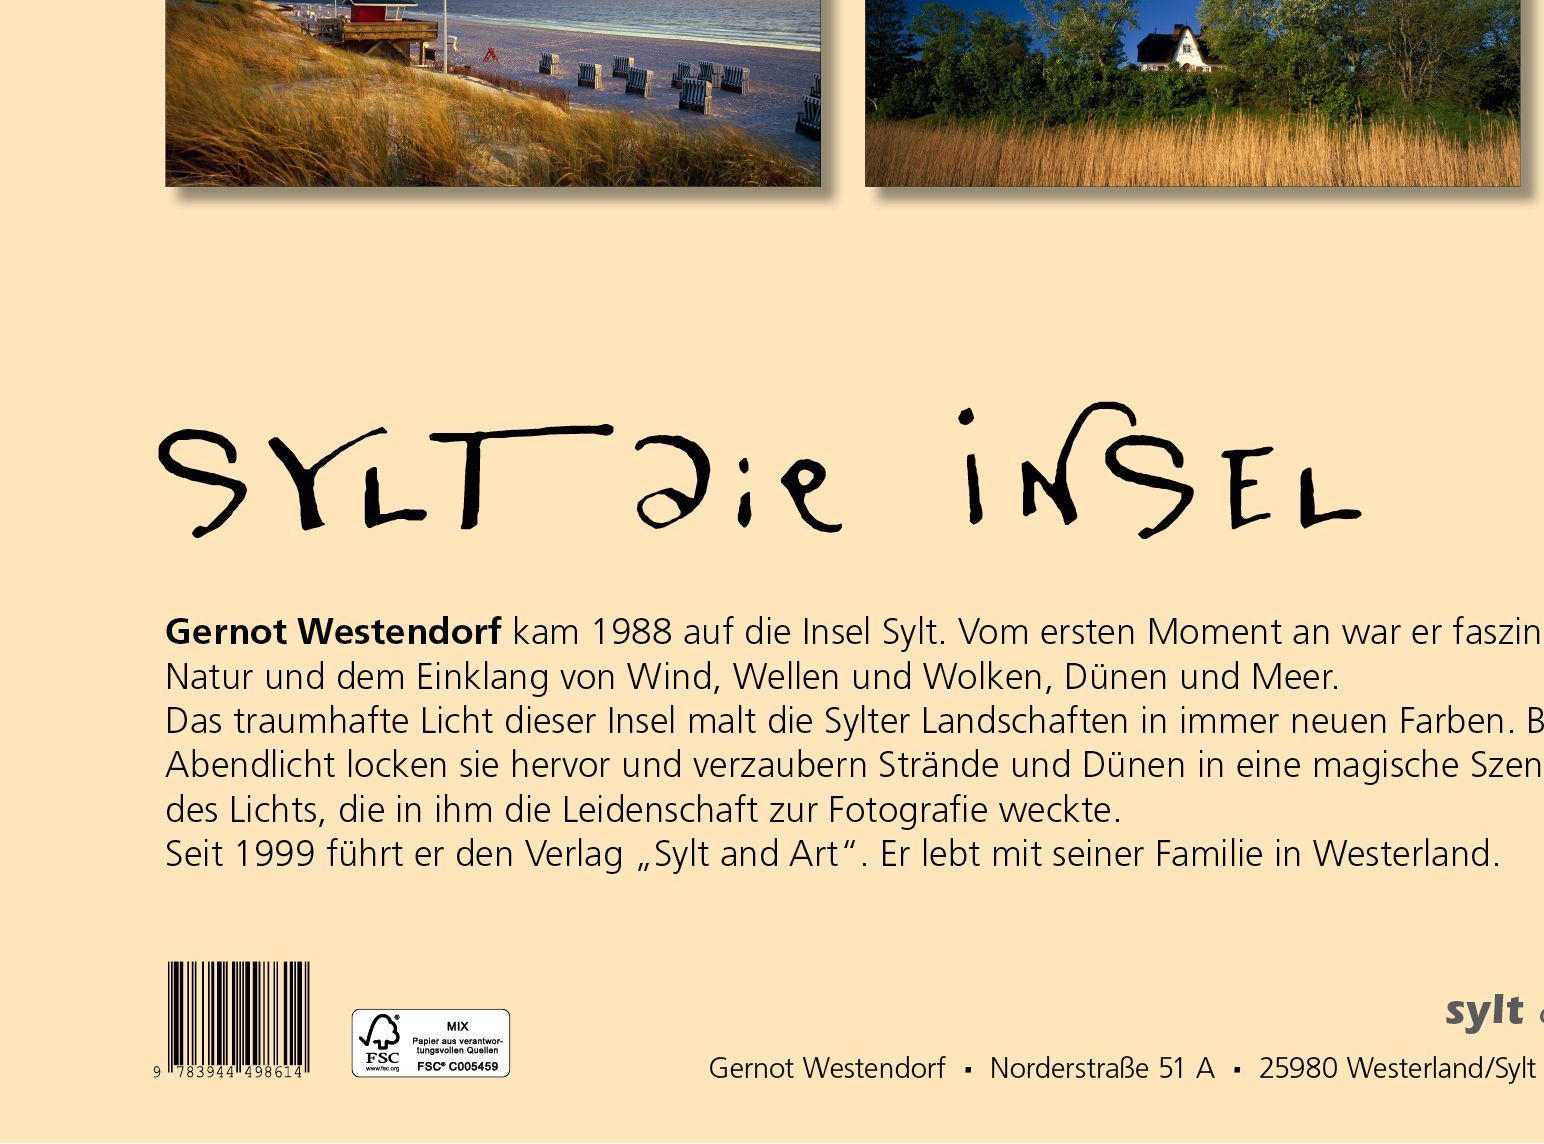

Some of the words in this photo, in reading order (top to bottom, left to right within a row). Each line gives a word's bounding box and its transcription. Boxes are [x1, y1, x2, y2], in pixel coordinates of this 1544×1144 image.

[157, 423, 615, 539] SYLT
[634, 434, 843, 534] die
[165, 617, 288, 646] Gernot
[296, 615, 503, 646] Westendorf
[514, 615, 578, 645] kam
[593, 617, 672, 645] 1988
[683, 615, 735, 645] auf
[745, 615, 791, 645] die
[804, 615, 870, 645] Insel
[883, 615, 945, 653] Sylt.
[957, 617, 1028, 645] Vom
[1040, 619, 1135, 645] ersten
[1149, 617, 1283, 645] Moment
[1292, 624, 1330, 645] an
[1341, 624, 1402, 645] war
[1411, 624, 1443, 645] er
[167, 662, 254, 690] Natur
[266, 660, 324, 690] und
[337, 660, 404, 690] dem
[418, 660, 548, 698] Einklang
[559, 669, 615, 690] von
[626, 660, 720, 695] Wind,
[732, 660, 839, 690] Wellen
[853, 660, 911, 690] und
[922, 660, 1052, 695] Wolken,
[1066, 662, 1167, 690] Dünen
[1181, 660, 1239, 690] und
[1253, 662, 1338, 690] Meer.
[167, 706, 222, 734] Das
[233, 704, 409, 734] traumhafte
[422, 704, 494, 734] Licht
[505, 704, 597, 734] dieser
[609, 704, 675, 734] Insel
[689, 704, 757, 734] malt
[768, 704, 813, 734] die
[825, 704, 911, 742] Sylter
[923, 704, 1128, 735] Landschaften
[1142, 705, 1167, 734] in
[1181, 705, 1280, 734] immer
[1292, 713, 1387, 734] neuen
[1401, 704, 1514, 734] Farben.
[164, 748, 336, 778] Abendlicht
[348, 748, 447, 778] locken
[459, 749, 499, 778] sie
[512, 748, 611, 778] hervor
[623, 748, 681, 778] und
[692, 748, 867, 778] verzaubern
[879, 748, 999, 778] Strände
[1012, 748, 1070, 778] und
[1084, 750, 1185, 778] Dünen
[1199, 749, 1224, 778] in
[1236, 749, 1301, 778] eine
[1314, 748, 1459, 786] magische
[166, 838, 224, 867] Seit
[236, 839, 315, 867] 1999
[326, 837, 404, 867] führt
[414, 846, 445, 867] er
[456, 837, 513, 867] den
[524, 837, 622, 875] Verlag
[720, 837, 778, 867] and
[882, 839, 911, 867] Er
[923, 837, 981, 867] lebt
[993, 838, 1043, 867] mit
[1052, 838, 1145, 867] seiner
[1157, 837, 1263, 867] Familie
[1276, 838, 1301, 867] in
[1312, 837, 1499, 867] Westerland.
[1445, 993, 1524, 1035] sylt
[446, 1020, 471, 1032] MIX
[412, 1036, 440, 1047] Papier
[441, 1038, 457, 1046] aus
[458, 1036, 504, 1046] verantwor-
[365, 1051, 400, 1064] FSC
[416, 1045, 465, 1056] tungsvollen
[466, 1045, 499, 1055] Quellen
[152, 1065, 162, 1079] 9
[176, 1066, 234, 1079] 783944
[244, 1066, 302, 1079] 498614
[365, 1064, 400, 1073] www.fsc.org
[448, 1061, 500, 1072] C005459
[709, 1056, 795, 1079] Gernot
[802, 1055, 947, 1079] Westendorf
[991, 1055, 1149, 1079] Norderstraße
[1159, 1056, 1183, 1079] 51
[1195, 1056, 1216, 1079] A
[1259, 1056, 1338, 1079] 25980
[1346, 1055, 1537, 1085] Westerland/Sylt
